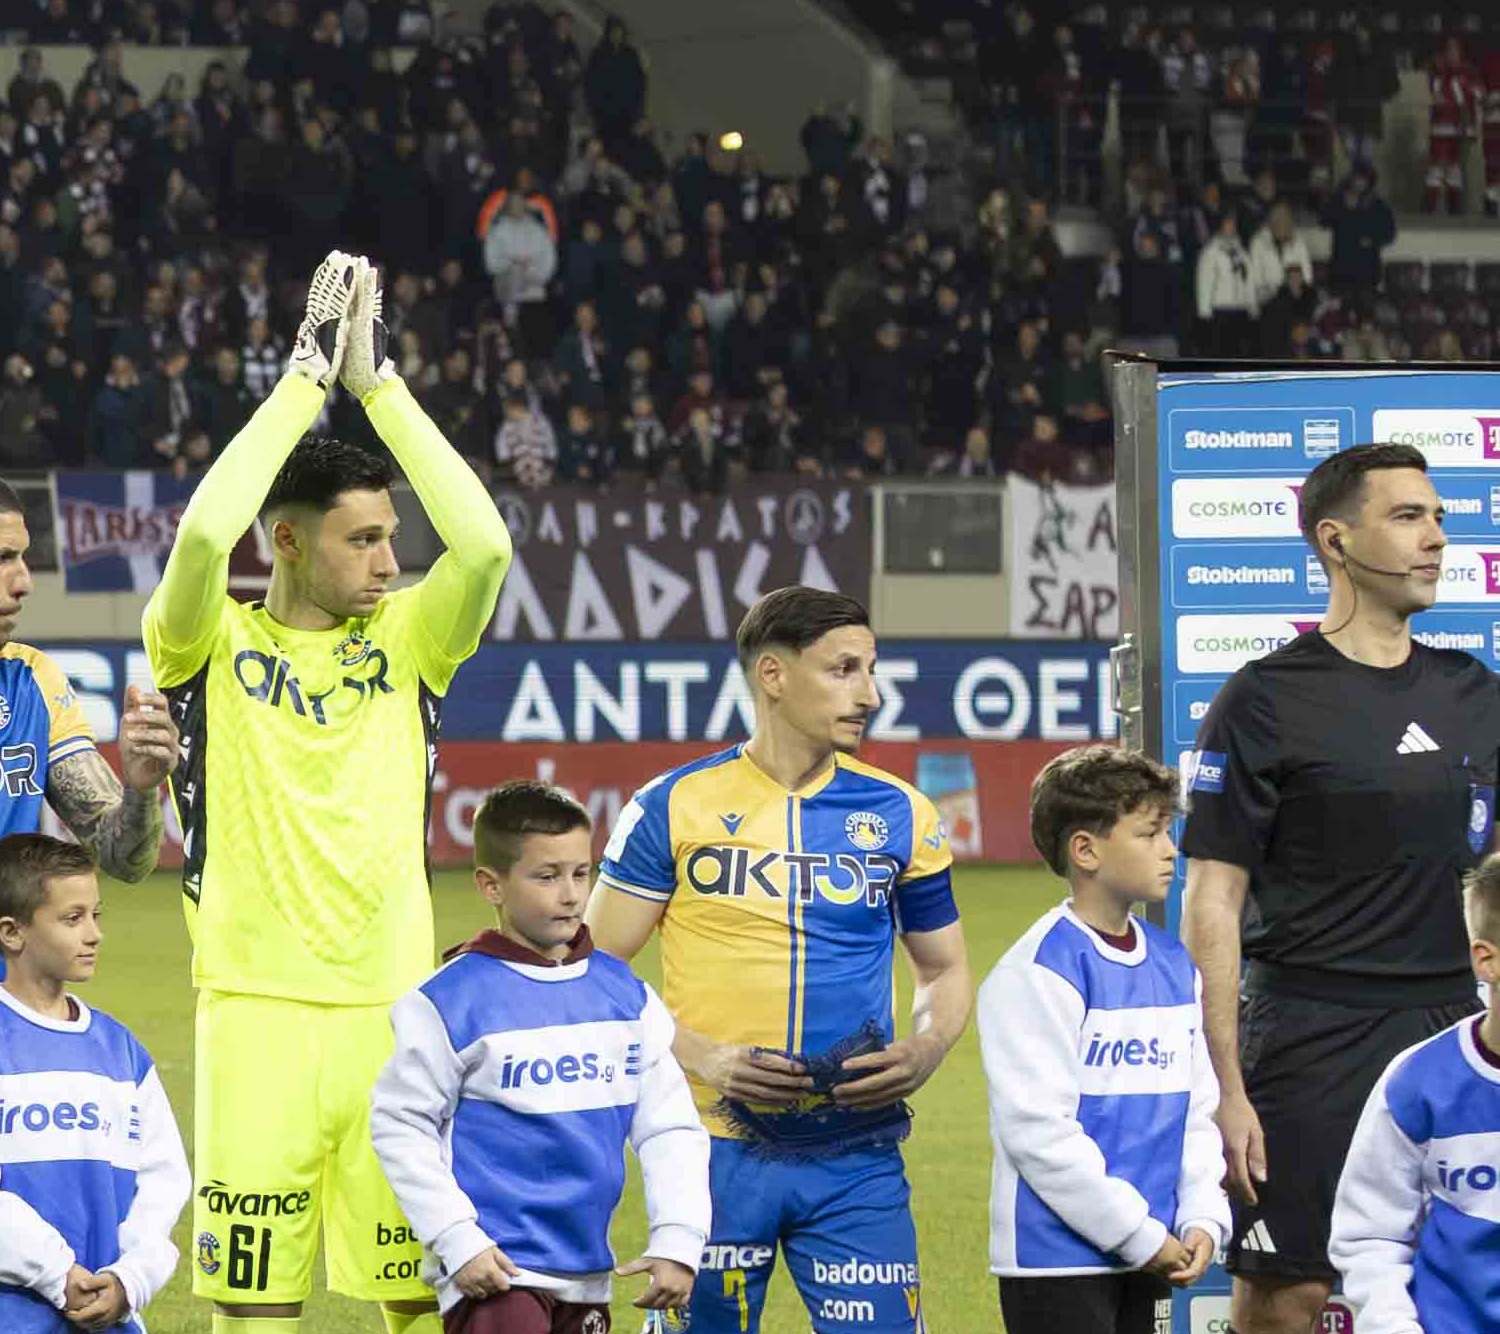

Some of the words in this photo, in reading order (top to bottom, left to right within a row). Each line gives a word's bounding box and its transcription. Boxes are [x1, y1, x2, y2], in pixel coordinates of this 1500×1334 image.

[1189, 501, 1288, 518] COSMOTE
[1186, 566, 1296, 585] Stoiximan
[207, 1188, 311, 1218] avance
[226, 1223, 272, 1292] 61
[700, 1244, 773, 1269] ance
[819, 1297, 875, 1322] .com
